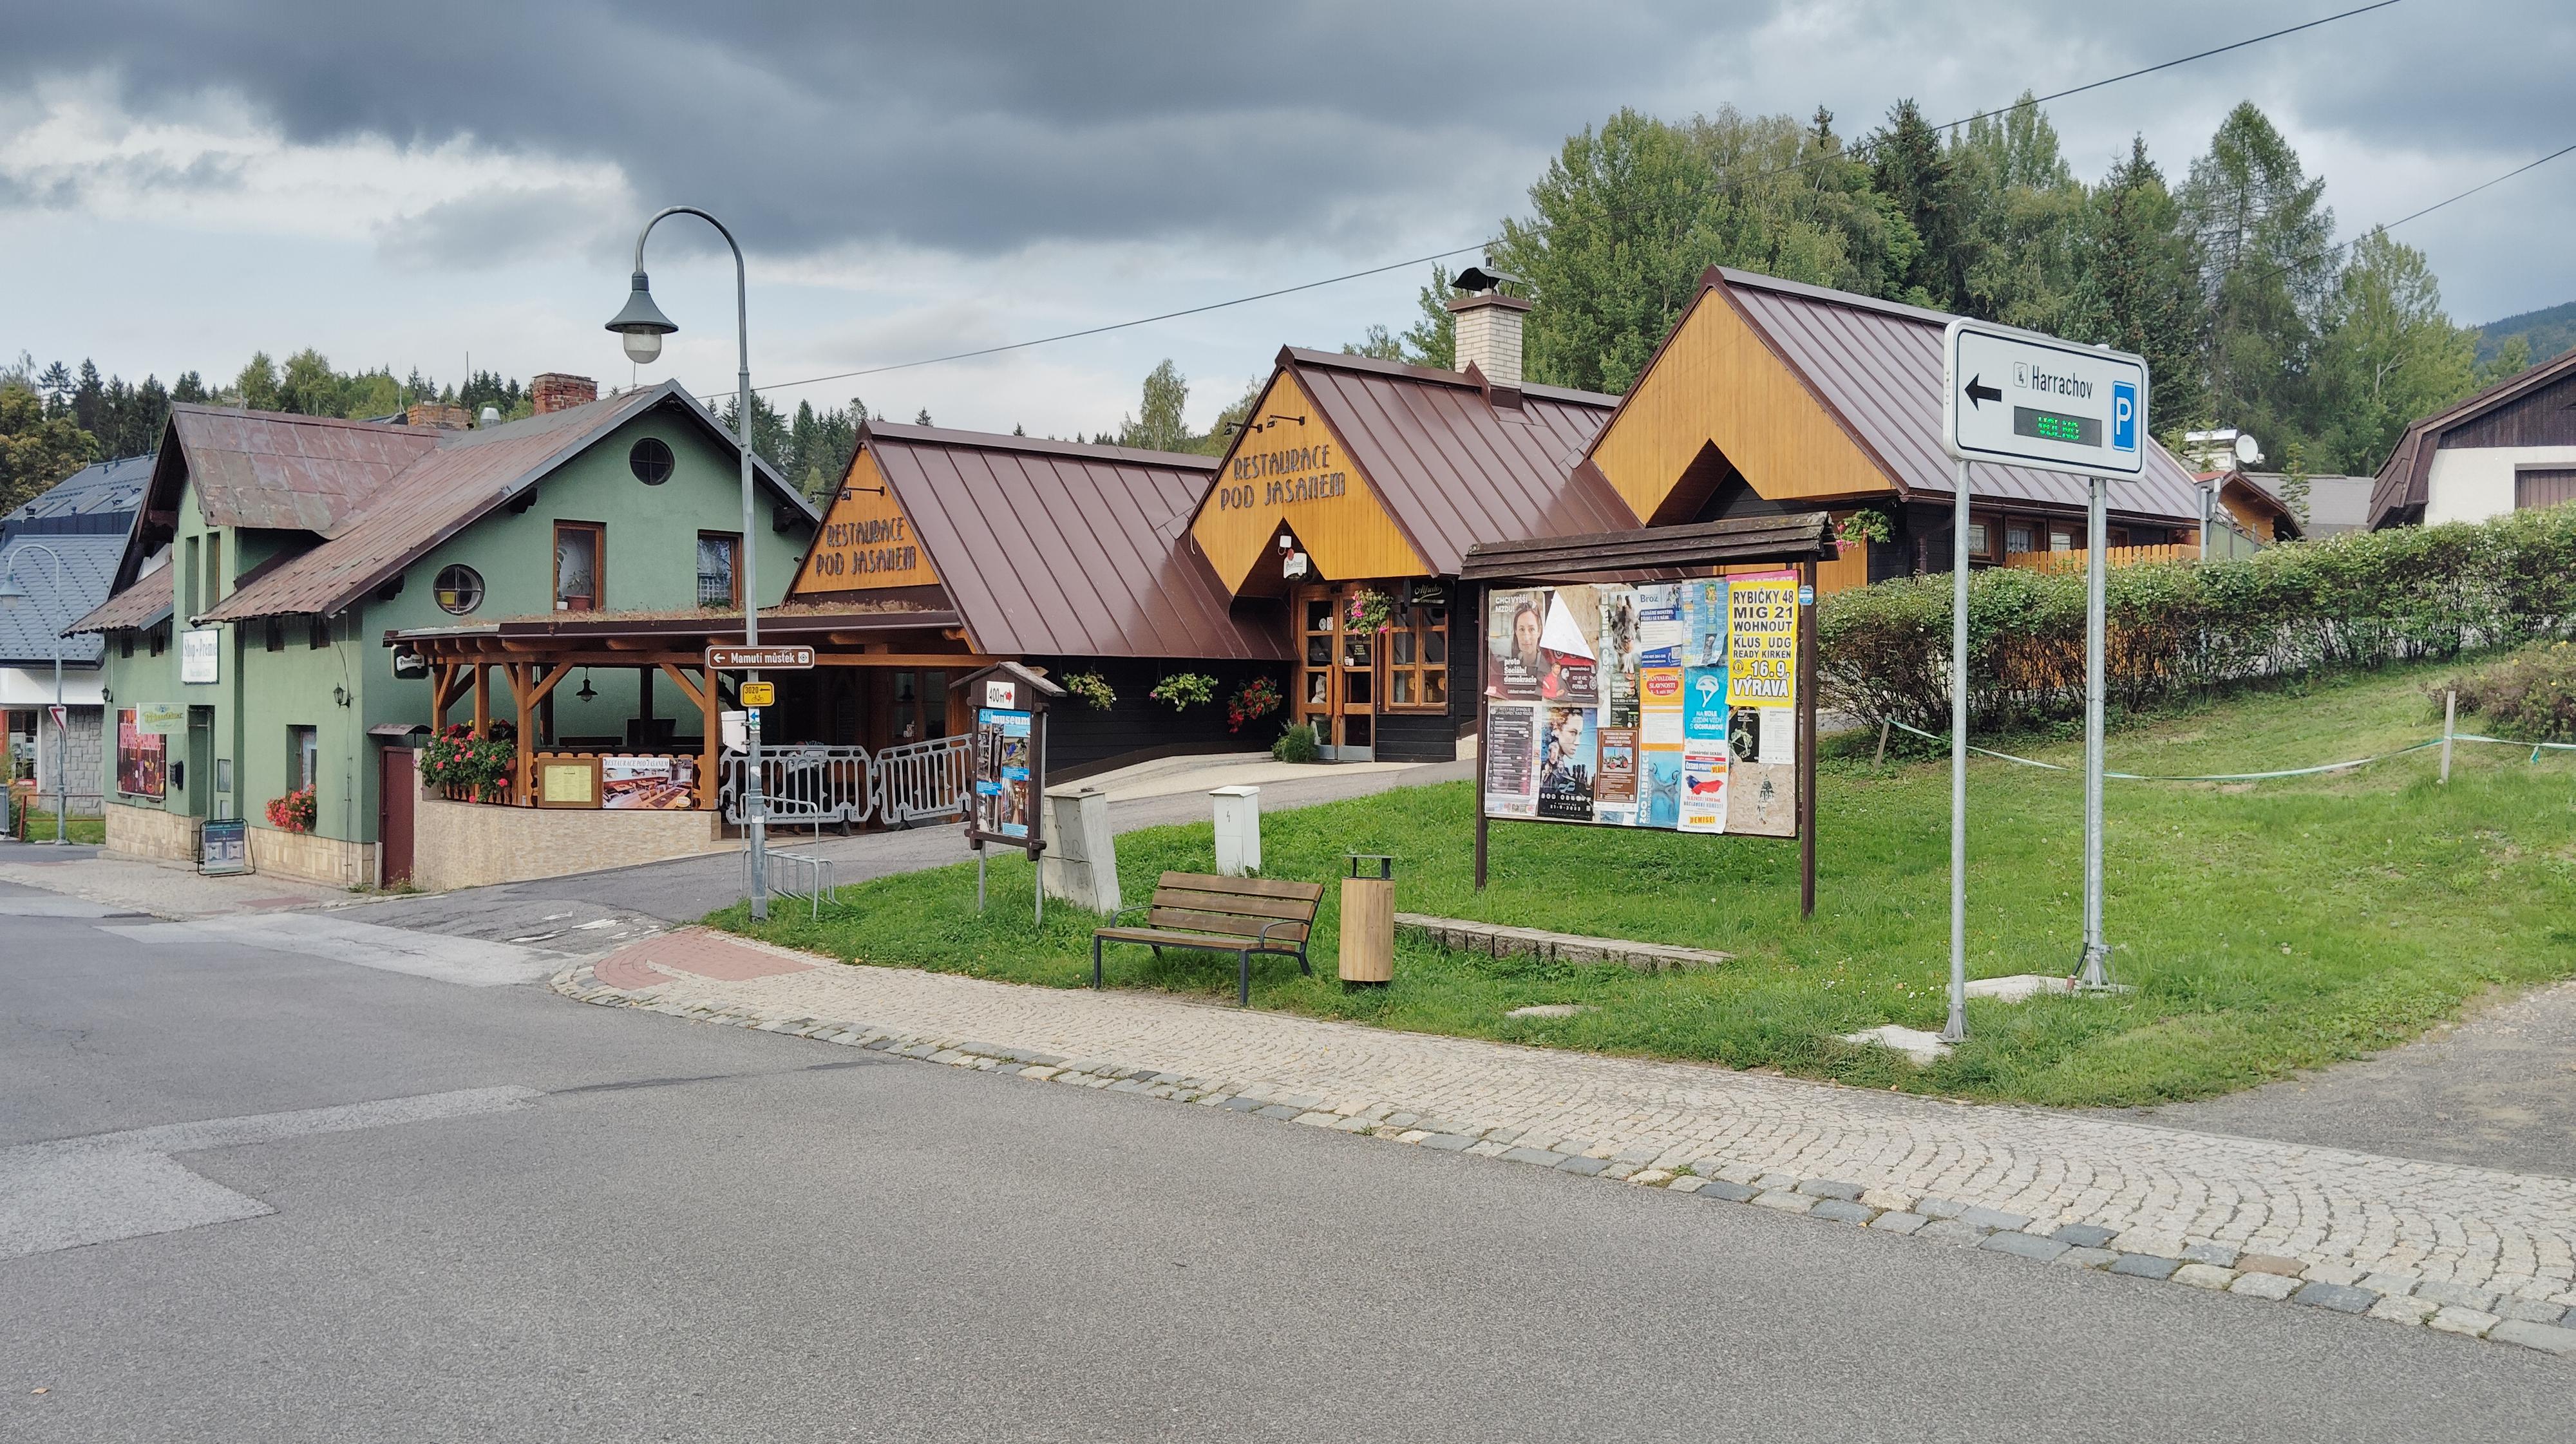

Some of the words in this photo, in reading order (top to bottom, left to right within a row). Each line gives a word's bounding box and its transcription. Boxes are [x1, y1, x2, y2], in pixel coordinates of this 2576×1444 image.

[2032, 364, 2093, 399] Harrachov
[2116, 397, 2132, 435] P
[1233, 444, 1331, 481] RESTAURACE
[1220, 485, 1255, 511] POD
[1264, 471, 1345, 506] JASANEM
[826, 516, 904, 548] RESTAURACE
[816, 552, 844, 577] POD
[851, 545, 916, 575] JASANEM
[1495, 596, 1511, 605] CHCI
[1640, 594, 1659, 603] Broz
[1733, 587, 1780, 605] RYBIČKY
[1783, 590, 1794, 604] 48
[1734, 606, 1768, 619] MIG
[1774, 606, 1793, 619] 21
[1733, 621, 1792, 632] WOHNOUT
[1734, 637, 1761, 648] KLUS
[1768, 637, 1792, 648] UDG
[731, 652, 762, 664] Mamuti
[764, 652, 795, 664] můstek
[1504, 658, 1520, 667] proto
[1733, 650, 1759, 659] READY
[1761, 650, 1791, 659] KIRKEN
[1750, 660, 1790, 678] 16.9.
[1503, 675, 1537, 683] demokracie
[1732, 675, 1789, 697] VÝRAVA
[1639, 800, 1647, 824] ZOO
